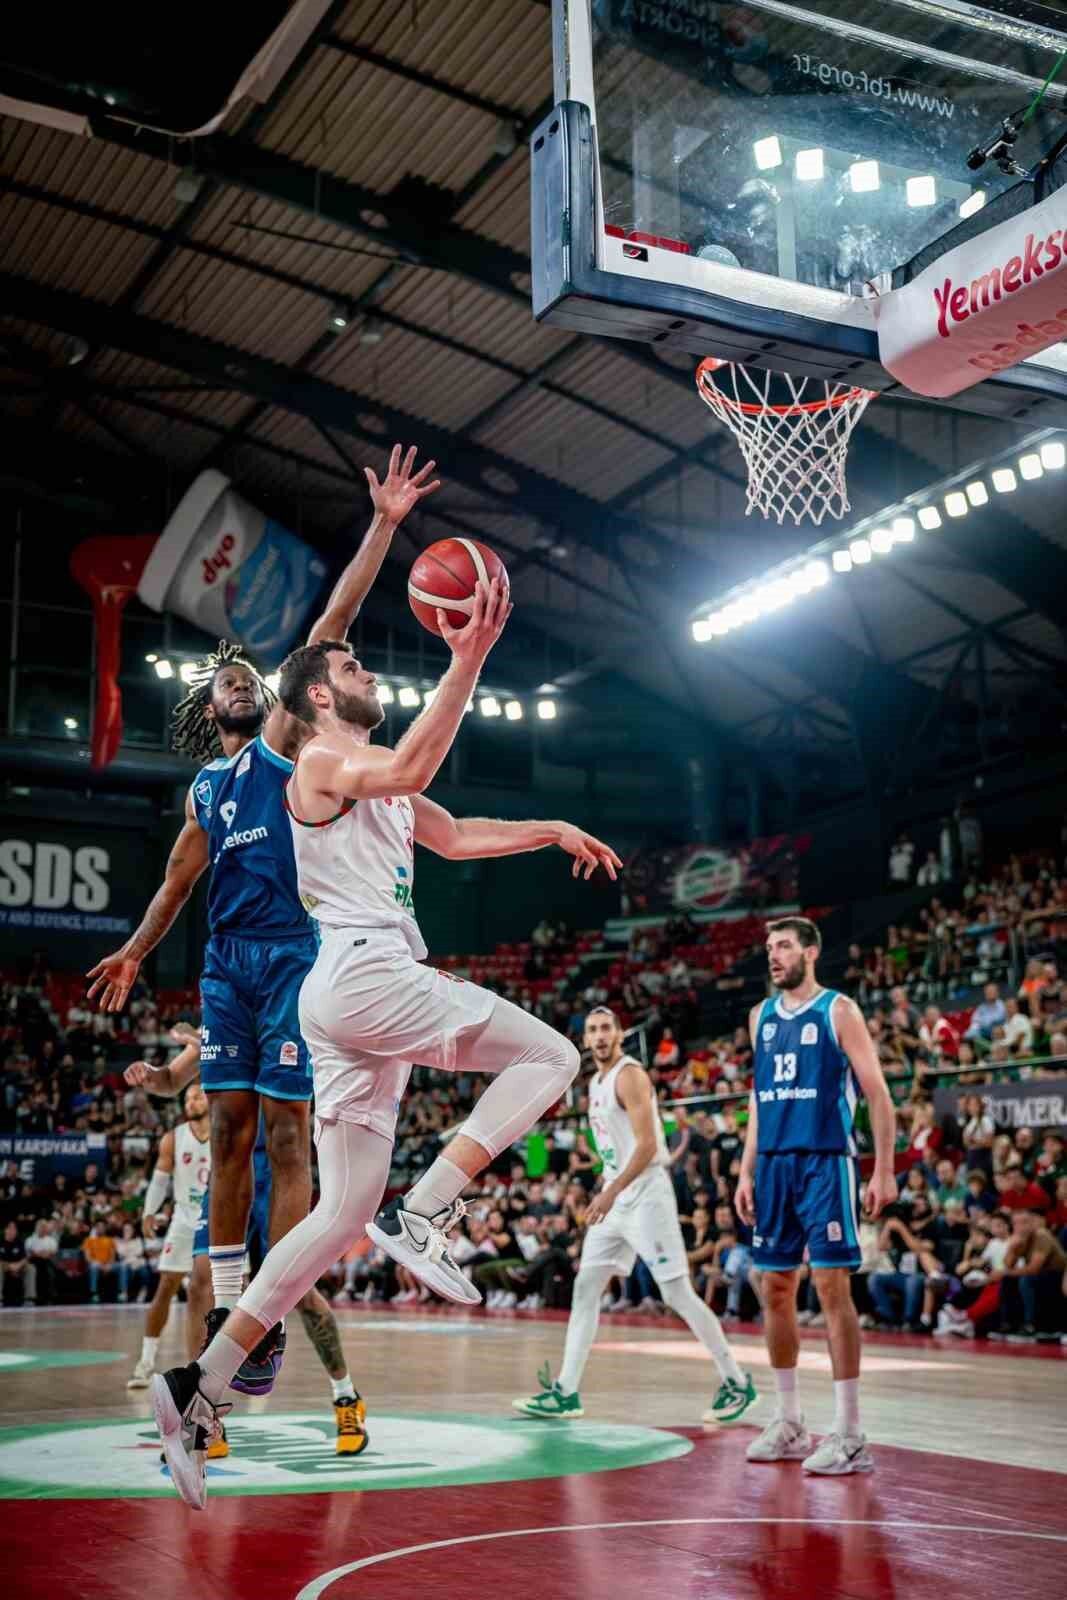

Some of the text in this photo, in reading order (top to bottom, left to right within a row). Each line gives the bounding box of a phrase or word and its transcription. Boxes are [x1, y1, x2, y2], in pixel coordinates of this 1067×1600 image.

[933, 229, 1067, 338] Yemeks
[0, 840, 110, 912] SDS
[774, 1052, 797, 1082] 13
[776, 1086, 817, 1101] Telekom
